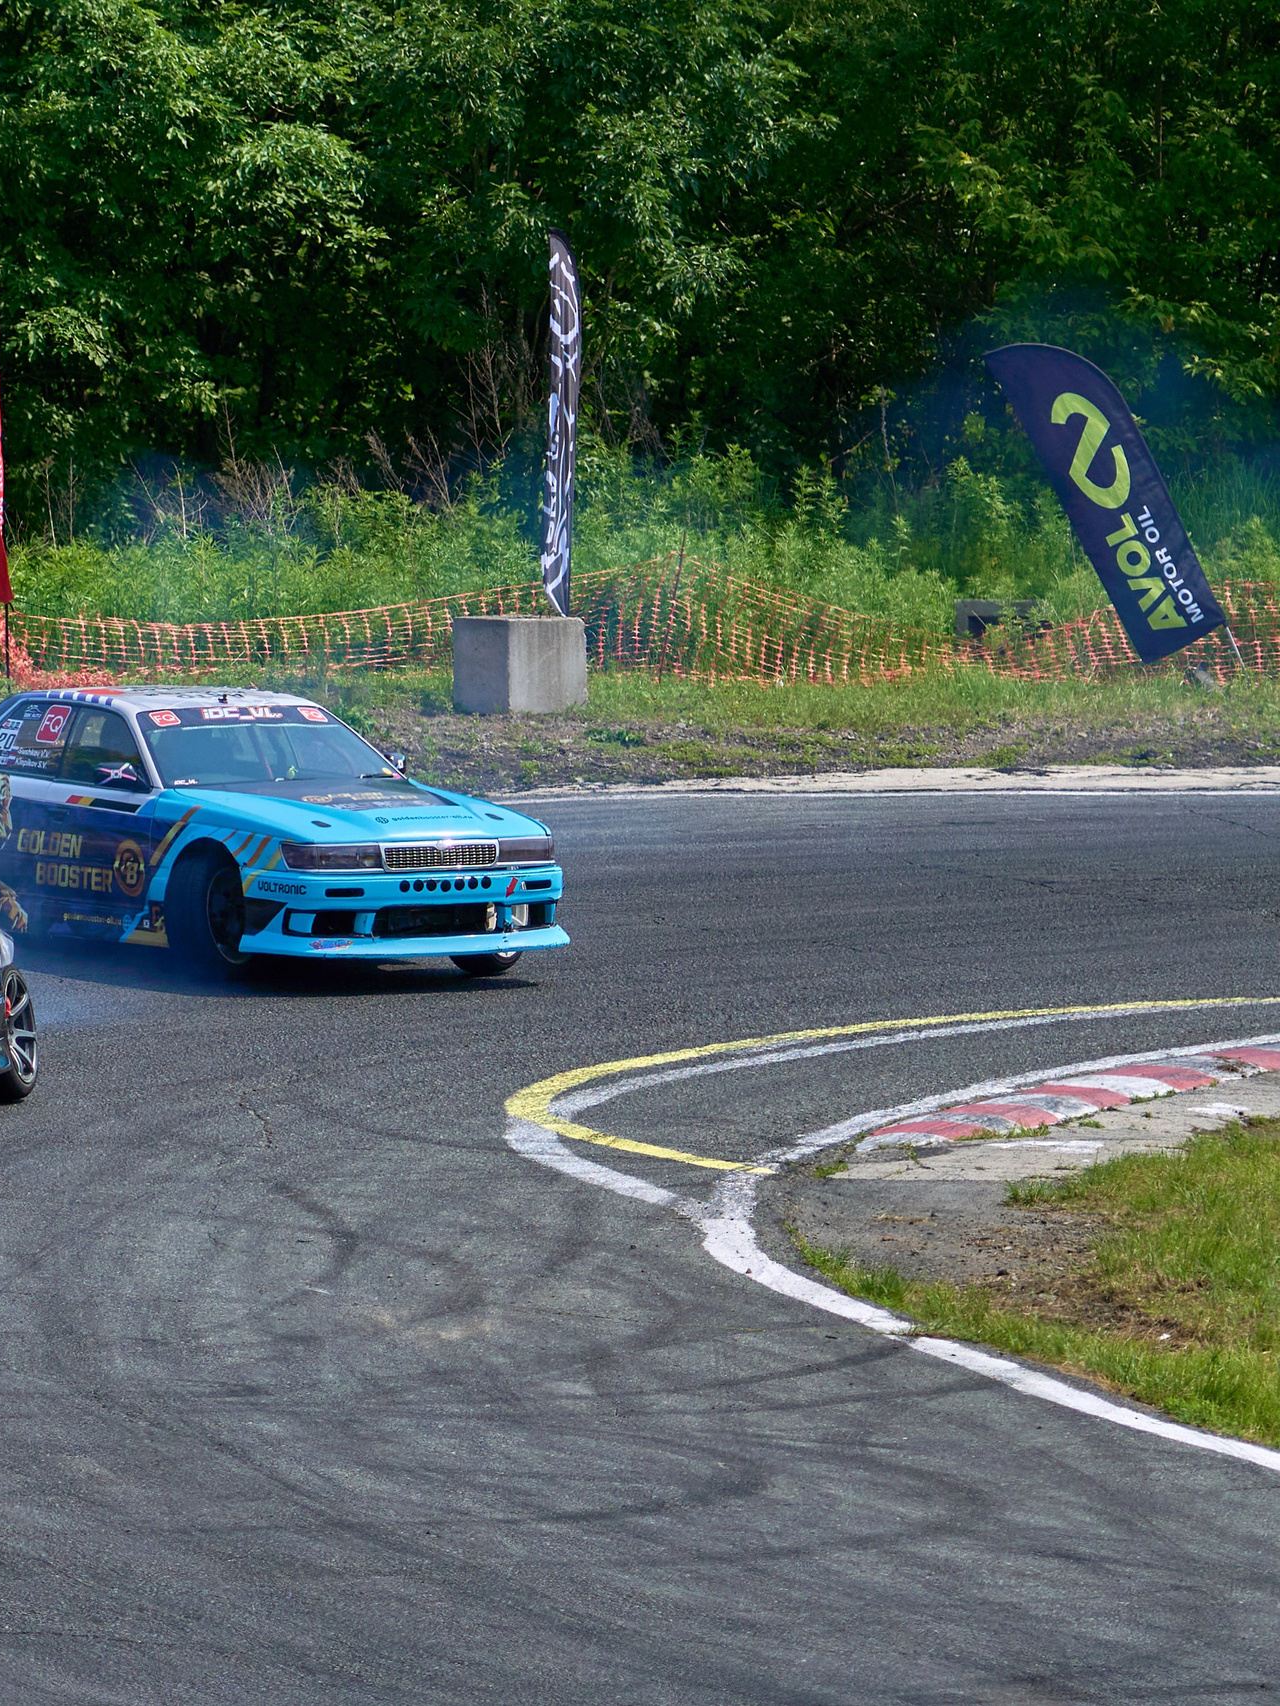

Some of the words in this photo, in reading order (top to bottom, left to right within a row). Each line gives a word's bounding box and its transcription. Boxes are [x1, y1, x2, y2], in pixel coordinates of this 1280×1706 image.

[1137, 505, 1160, 544] OIL
[1105, 512, 1188, 630] AVOL
[1155, 547, 1205, 623] MOTOR
[40, 713, 64, 733] FQ
[154, 714, 176, 724] FQ
[17, 828, 83, 858] GOLDEN
[36, 861, 113, 893] BOOSTER
[258, 880, 307, 896] VOLTRONIC
